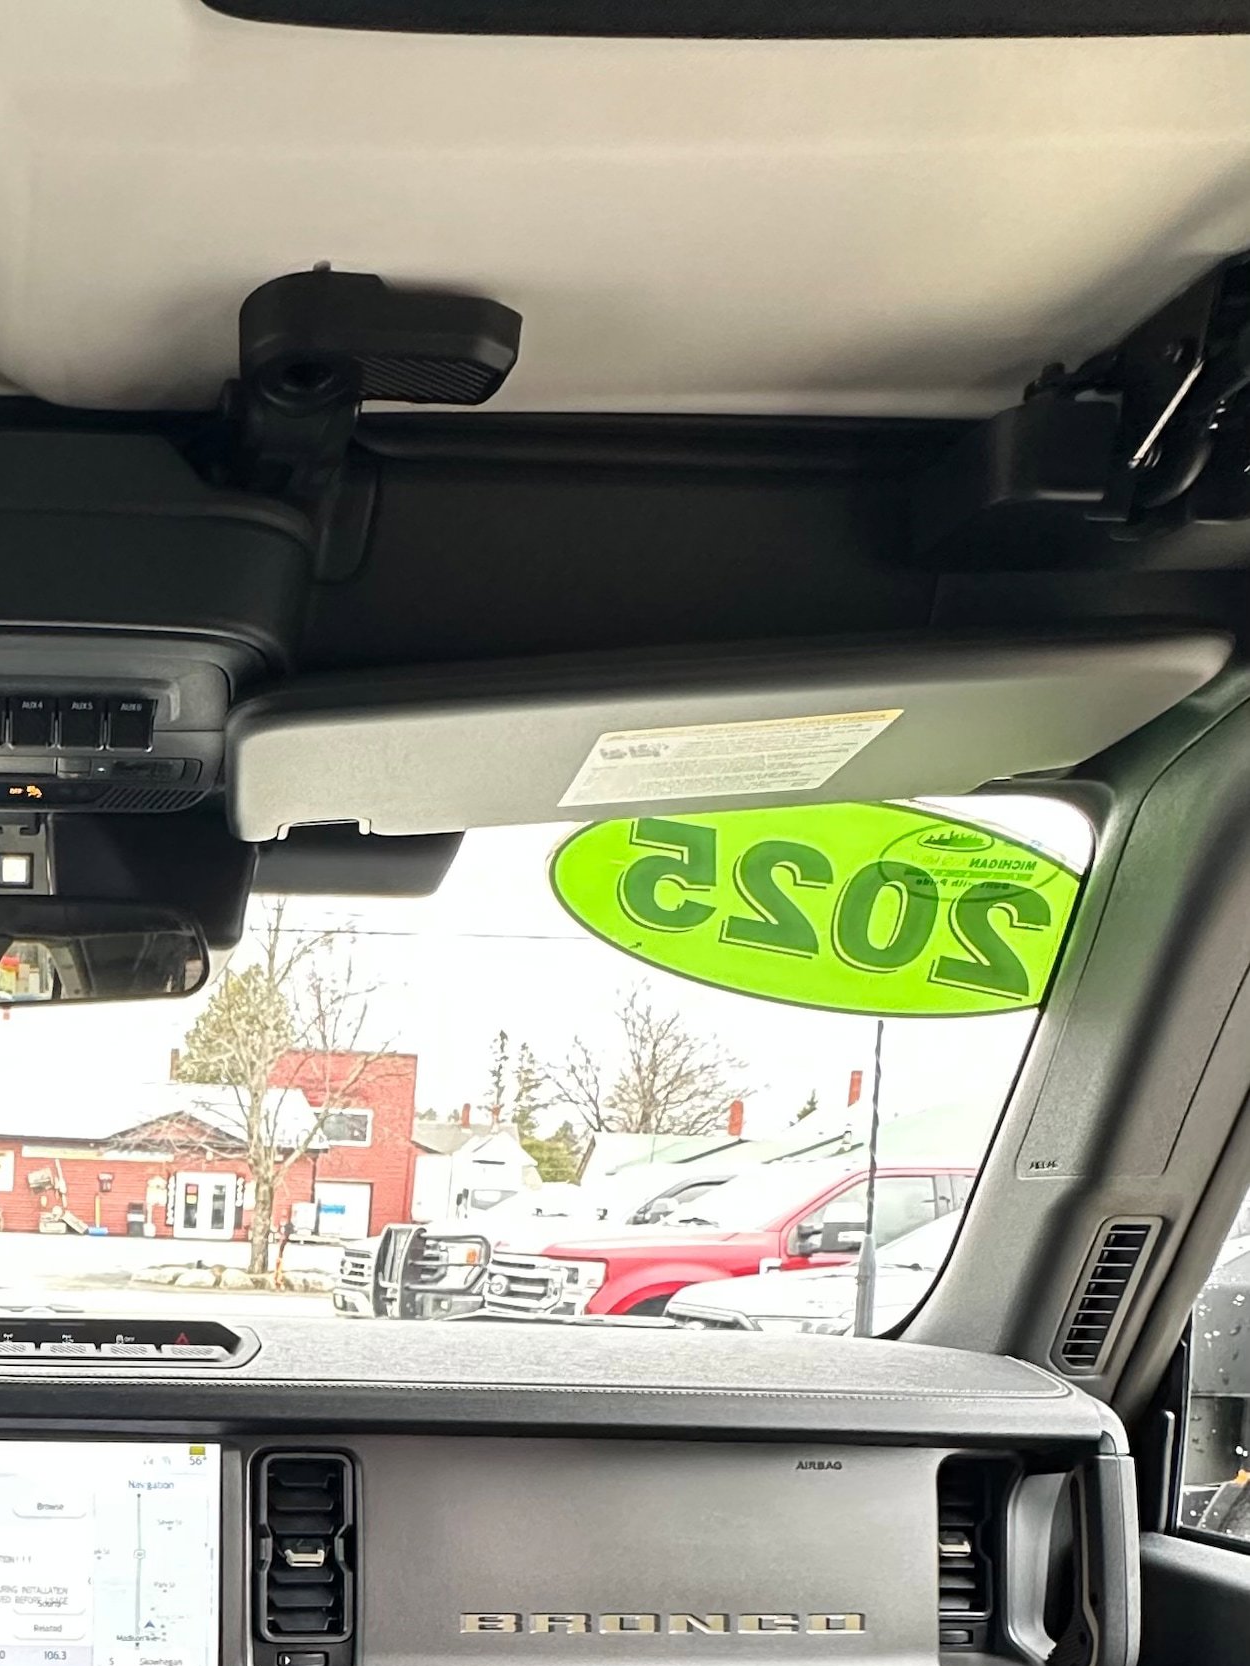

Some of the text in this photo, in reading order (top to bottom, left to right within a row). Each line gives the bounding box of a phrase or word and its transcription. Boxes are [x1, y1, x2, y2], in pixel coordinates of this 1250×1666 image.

[795, 1459, 843, 1471] AIRBAG
[459, 1612, 866, 1635] BRONCO
[43, 1650, 68, 1661] 106.3
